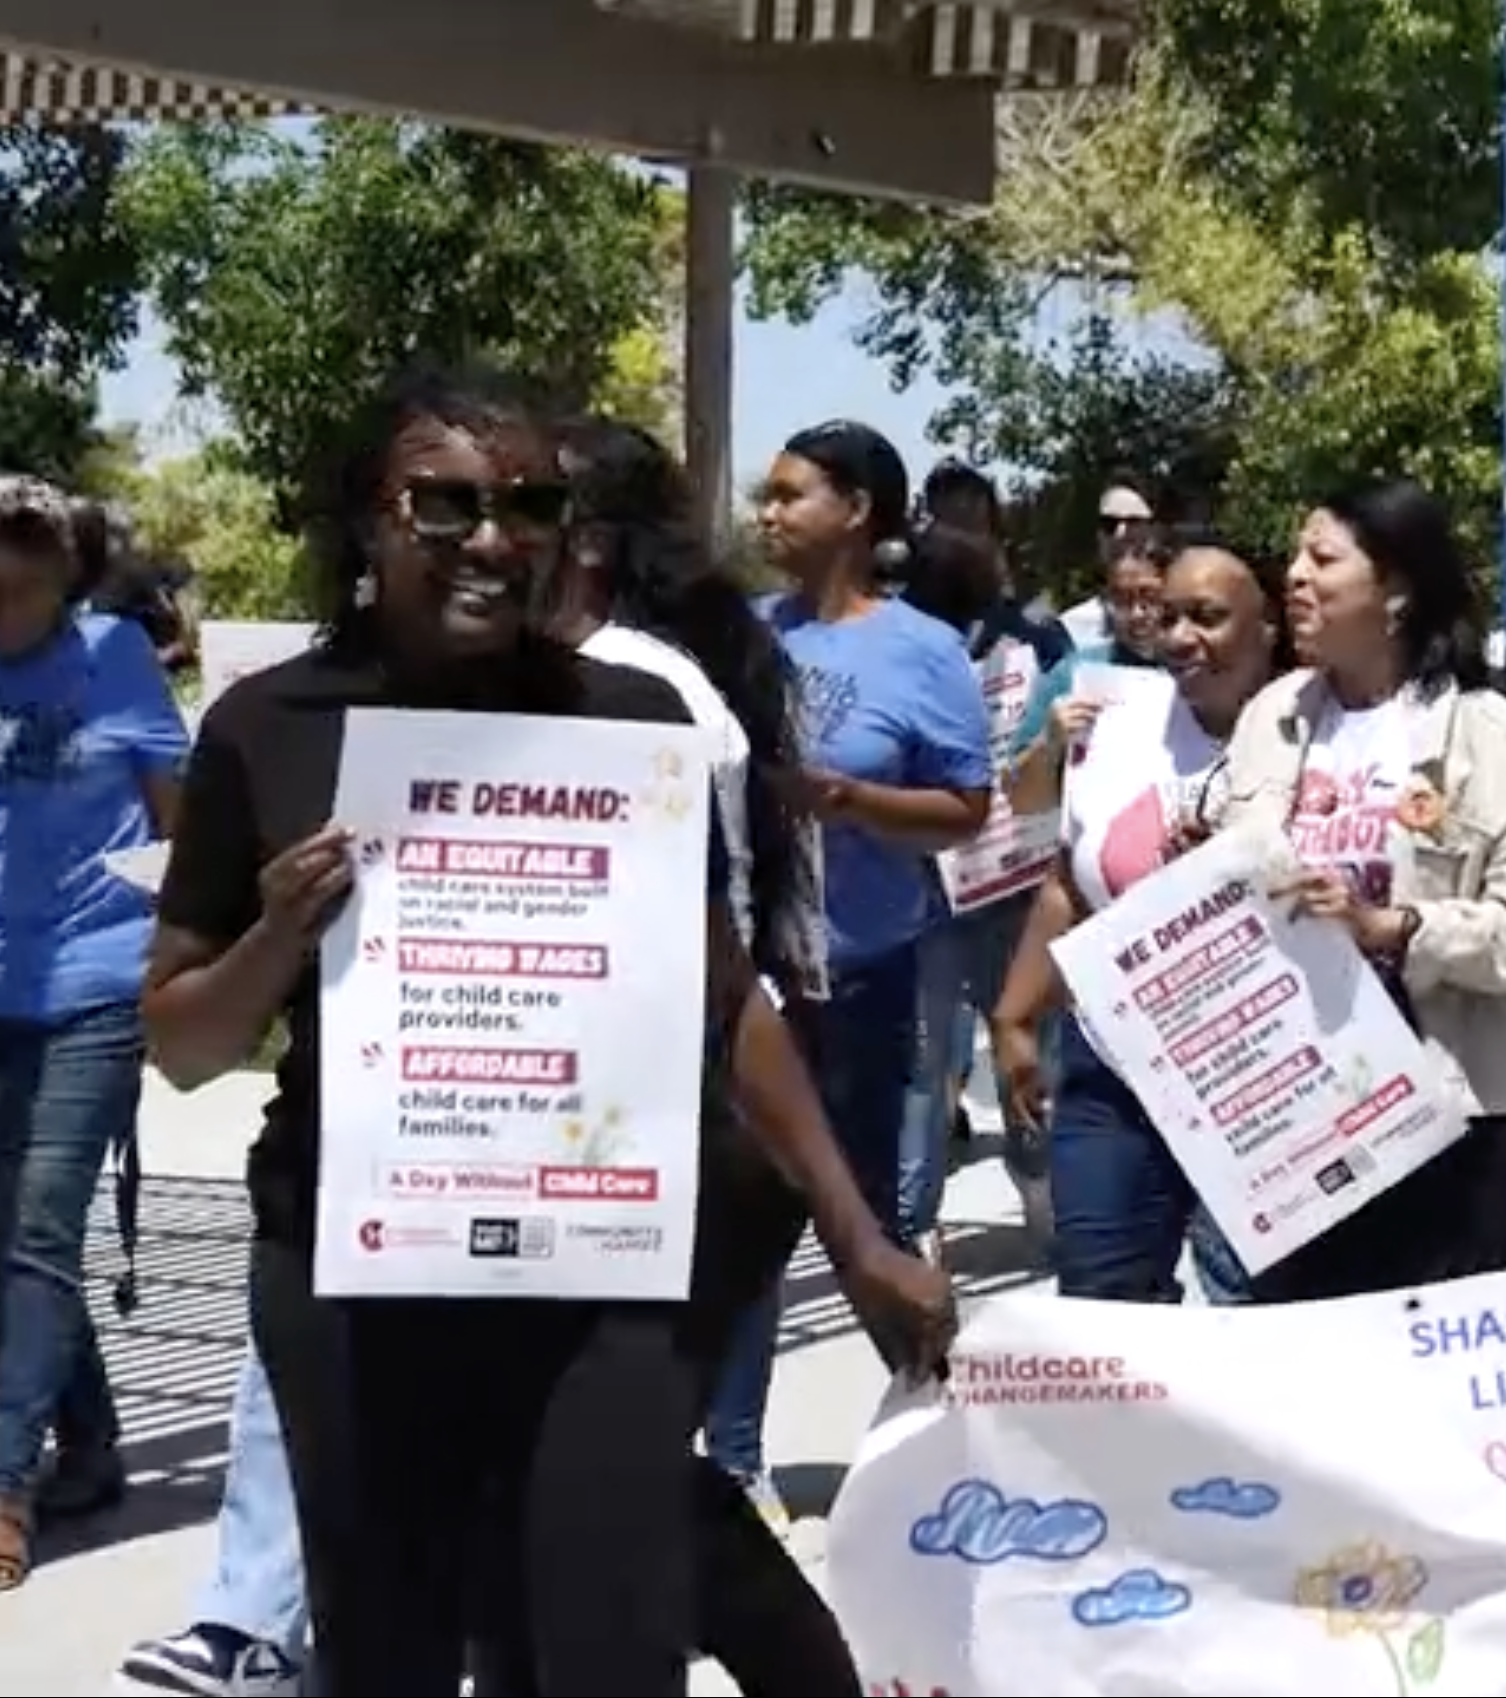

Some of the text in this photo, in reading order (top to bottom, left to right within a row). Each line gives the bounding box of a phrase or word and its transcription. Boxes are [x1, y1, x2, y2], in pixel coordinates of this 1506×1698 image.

[408, 779, 630, 821] WE DEMAND:
[401, 842, 593, 875] AN EQUITABLE
[1114, 878, 1258, 973] WE DEMAND:
[400, 943, 602, 974] THRIVING WAGES
[400, 984, 562, 1007] for child care
[399, 1007, 524, 1031] providers.
[406, 1051, 566, 1081] AFFORDABLE
[398, 1090, 583, 1113] child care for all
[398, 1115, 495, 1138] families.
[408, 1170, 447, 1192] Day
[543, 1172, 599, 1194] Child
[601, 1174, 651, 1196] Care
[956, 1382, 1169, 1406] HANGEMAKERS
